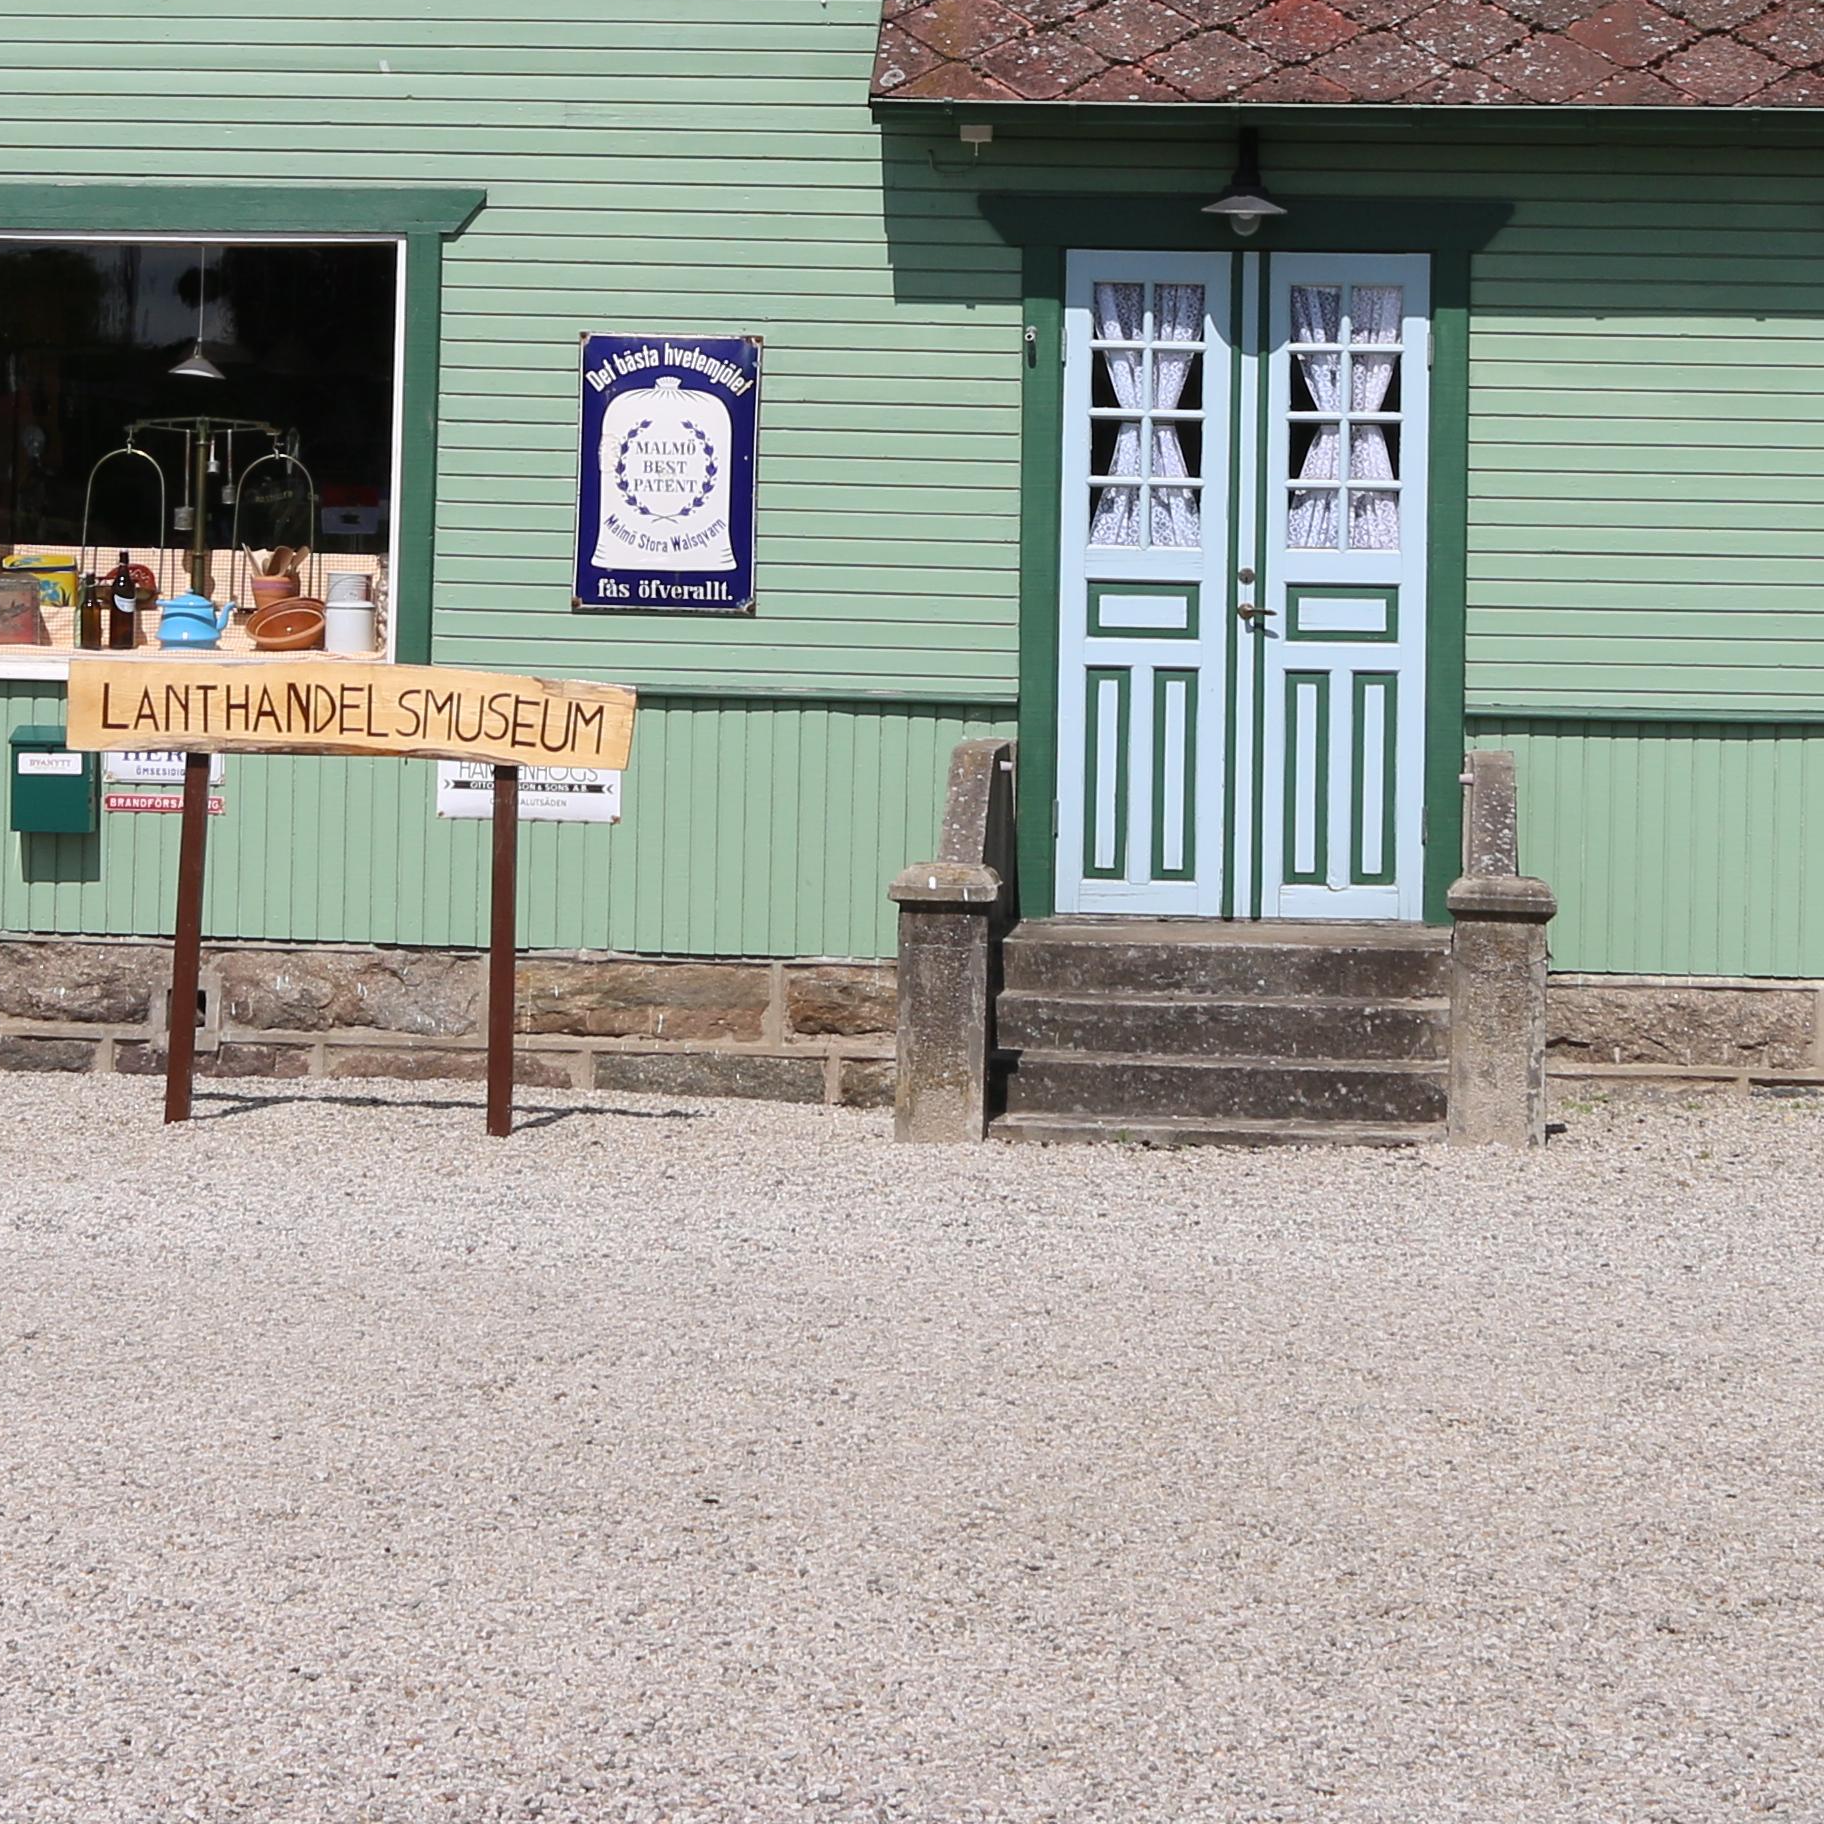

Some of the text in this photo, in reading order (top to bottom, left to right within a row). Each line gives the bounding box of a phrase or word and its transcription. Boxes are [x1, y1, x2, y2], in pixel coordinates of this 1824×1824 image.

[585, 342, 754, 397] Det bästa hvetemjölet
[636, 439, 697, 455] MALMÖ
[643, 460, 688, 475] BEST
[633, 479, 698, 493] PATENT
[604, 513, 638, 545] Malmö
[638, 534, 668, 553] Stora
[638, 579, 734, 601] öfverallt.
[101, 682, 605, 754] LANTHANDELSMUSEUM
[545, 783, 570, 792] SONS
